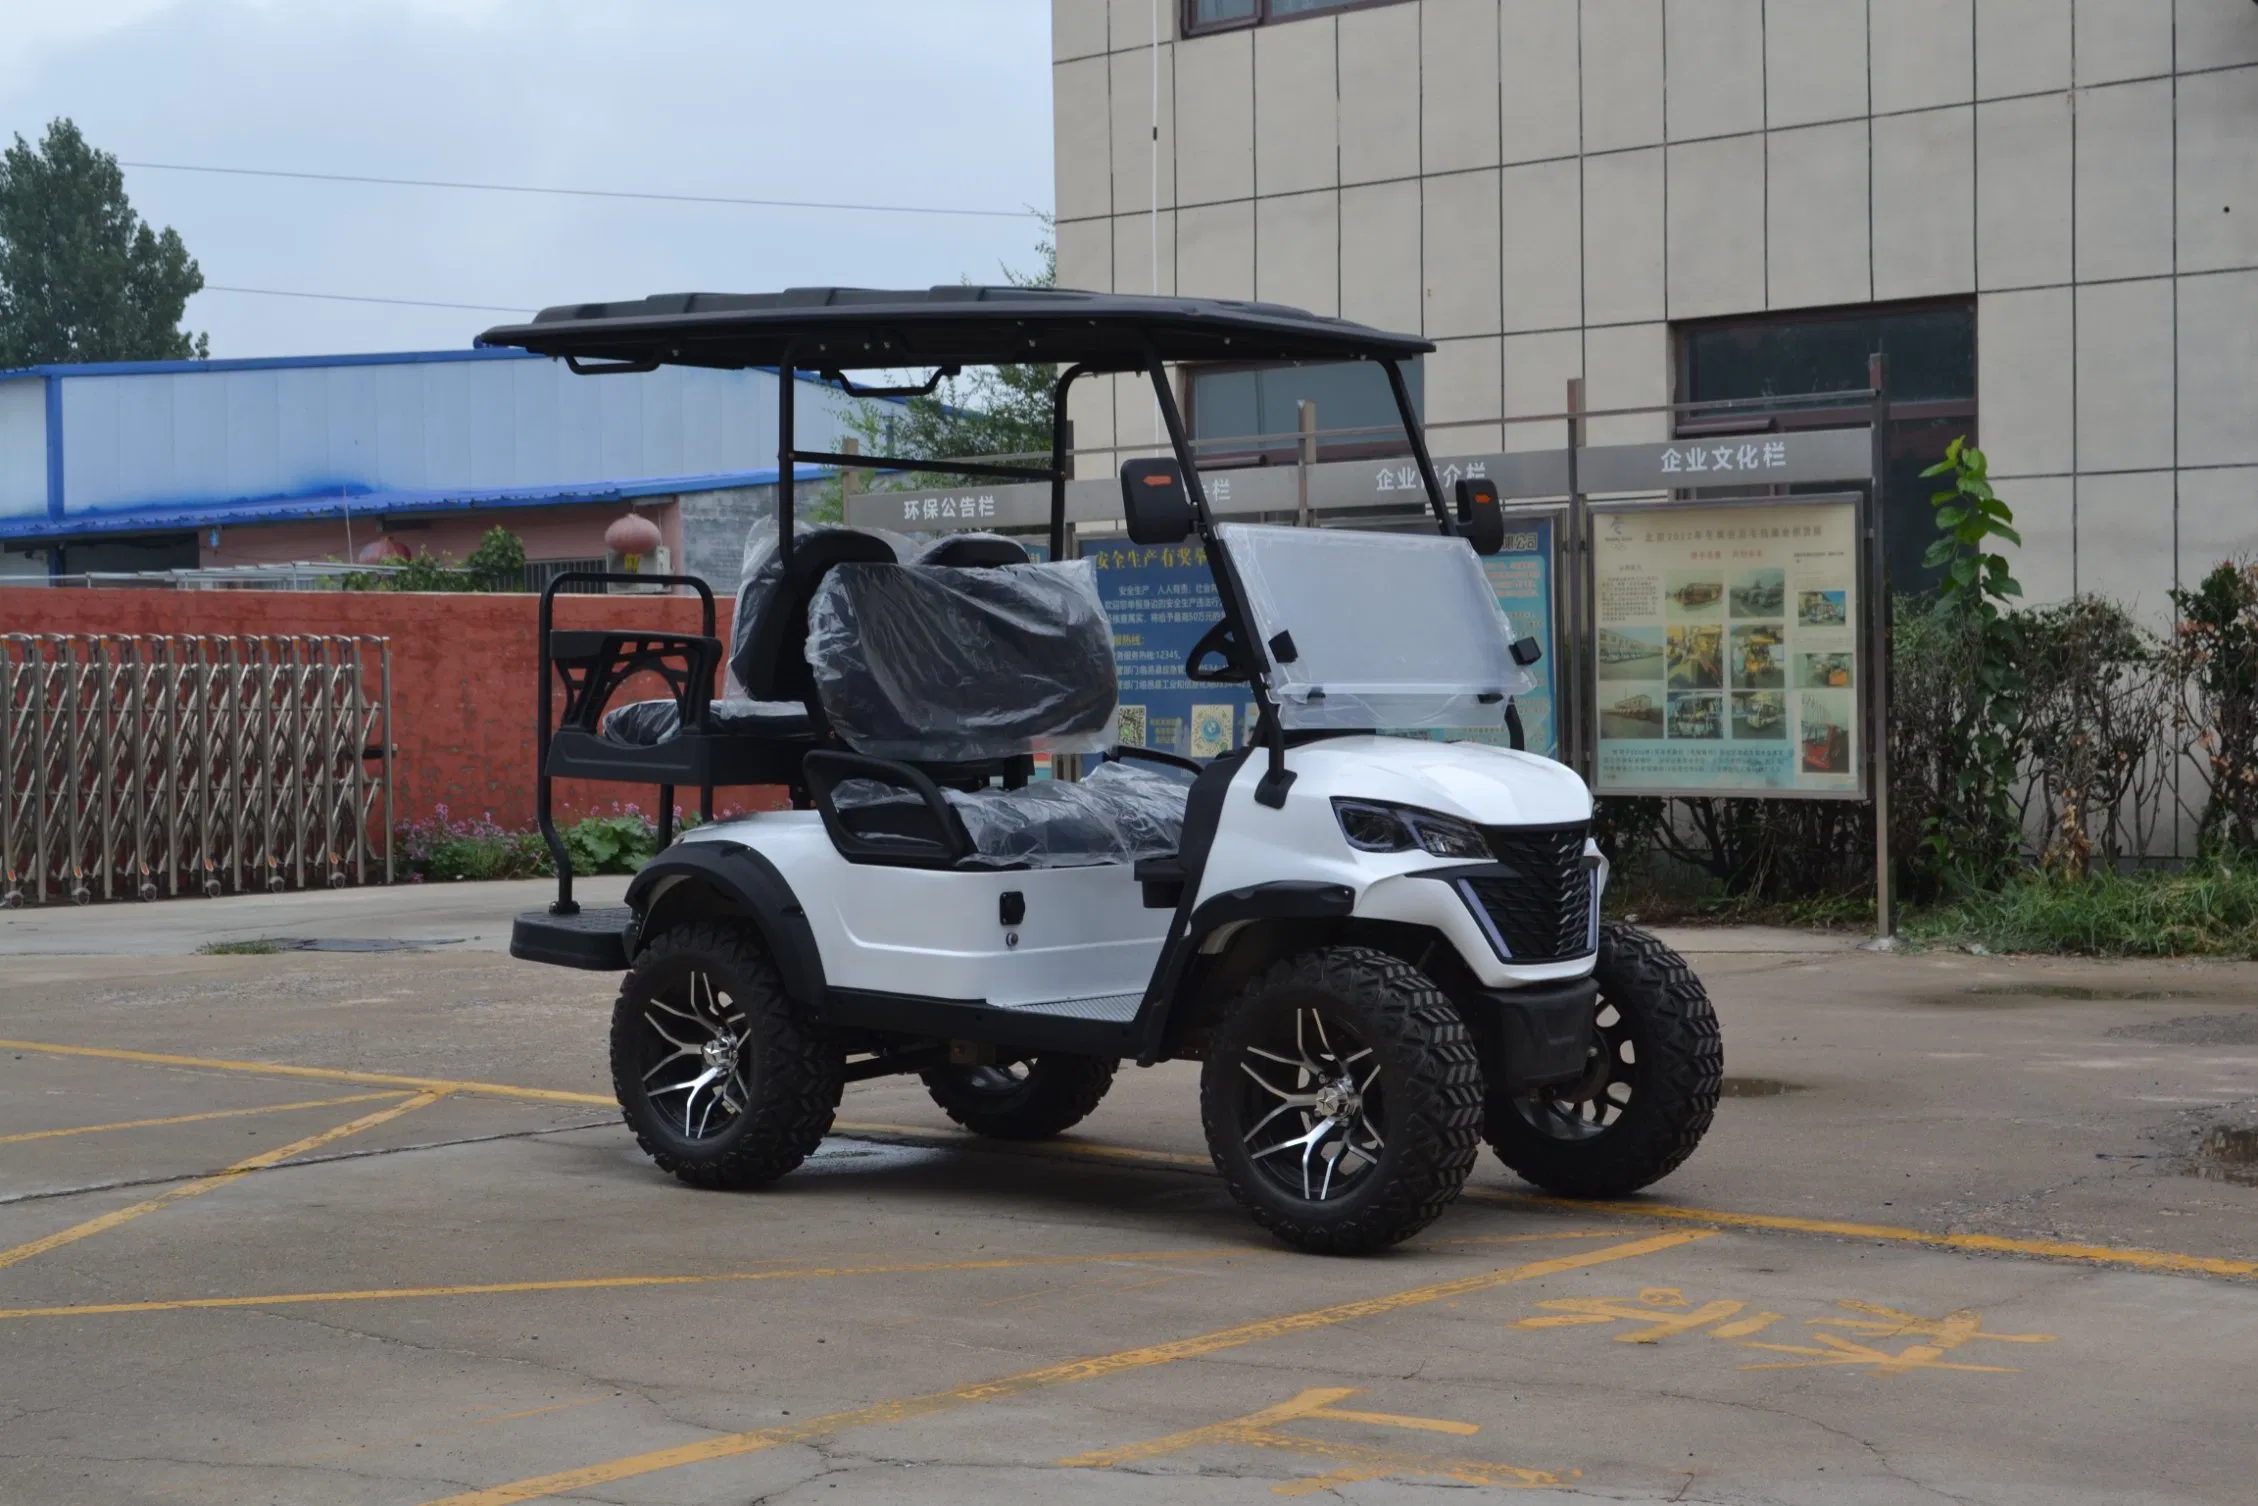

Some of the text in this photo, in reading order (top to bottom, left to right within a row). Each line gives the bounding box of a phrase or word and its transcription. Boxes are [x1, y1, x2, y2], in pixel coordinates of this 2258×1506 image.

[1660, 441, 1787, 472] 企业文化栏
[1375, 462, 1486, 492] 企业介栏
[903, 495, 996, 520] 环保公告栏
